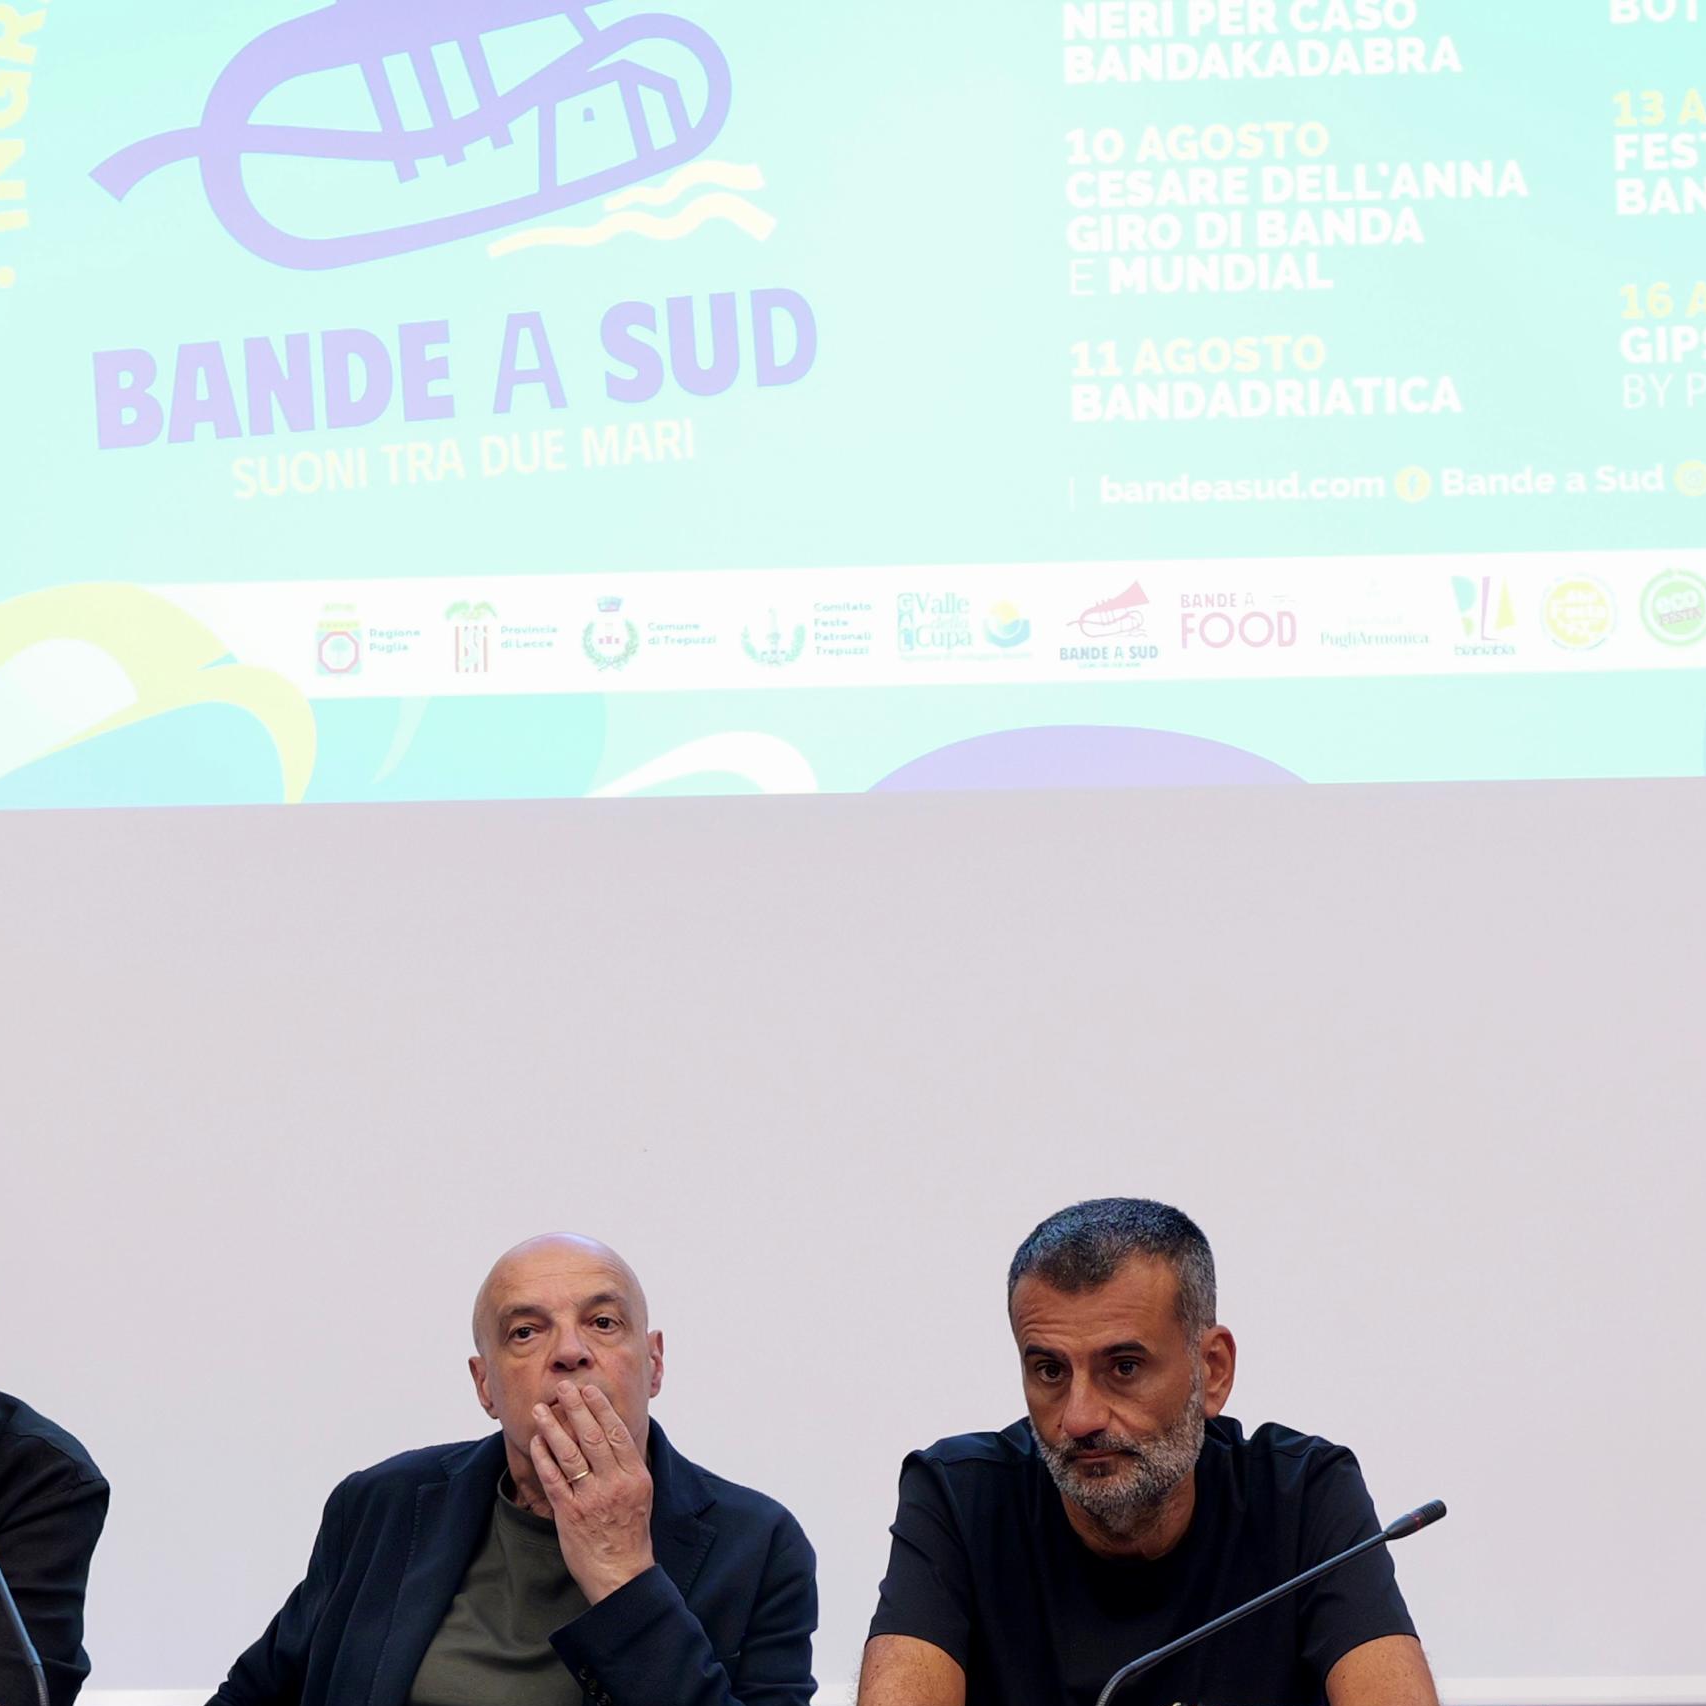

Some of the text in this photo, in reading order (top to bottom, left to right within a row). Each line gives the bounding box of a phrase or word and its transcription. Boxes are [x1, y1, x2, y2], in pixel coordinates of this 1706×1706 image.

[1061, 0, 1417, 41] NERI PER CASO
[1062, 36, 1463, 84] BANDAKADABRA
[1612, 89, 1666, 127] 13
[1065, 121, 1330, 164] 10 AGOSTO
[1065, 160, 1530, 209] CESARE DELL'ANNA
[1065, 207, 1425, 253] GIRO DI BANDA
[1069, 252, 1335, 297] E MUNDIAL
[1619, 282, 1674, 319] 16
[93, 286, 820, 452] BANDE A SUD
[1069, 335, 1327, 377] 11 AGOSTO
[1070, 376, 1463, 424] BANDADRIATICA
[1621, 371, 1674, 409] BY
[229, 417, 697, 503] SUONI TRA DUE MARI
[1100, 472, 1387, 505] bandeasud.com
[1441, 464, 1555, 498] Bande
[1565, 471, 1587, 495] a
[1594, 462, 1665, 495] Sud
[915, 591, 972, 616] Valle
[1180, 592, 1238, 609] BANDE
[1243, 591, 1257, 607] A
[914, 627, 974, 652] Cupa
[1180, 609, 1299, 650] FOOD
[1058, 643, 1160, 662] BANDE A SUD
